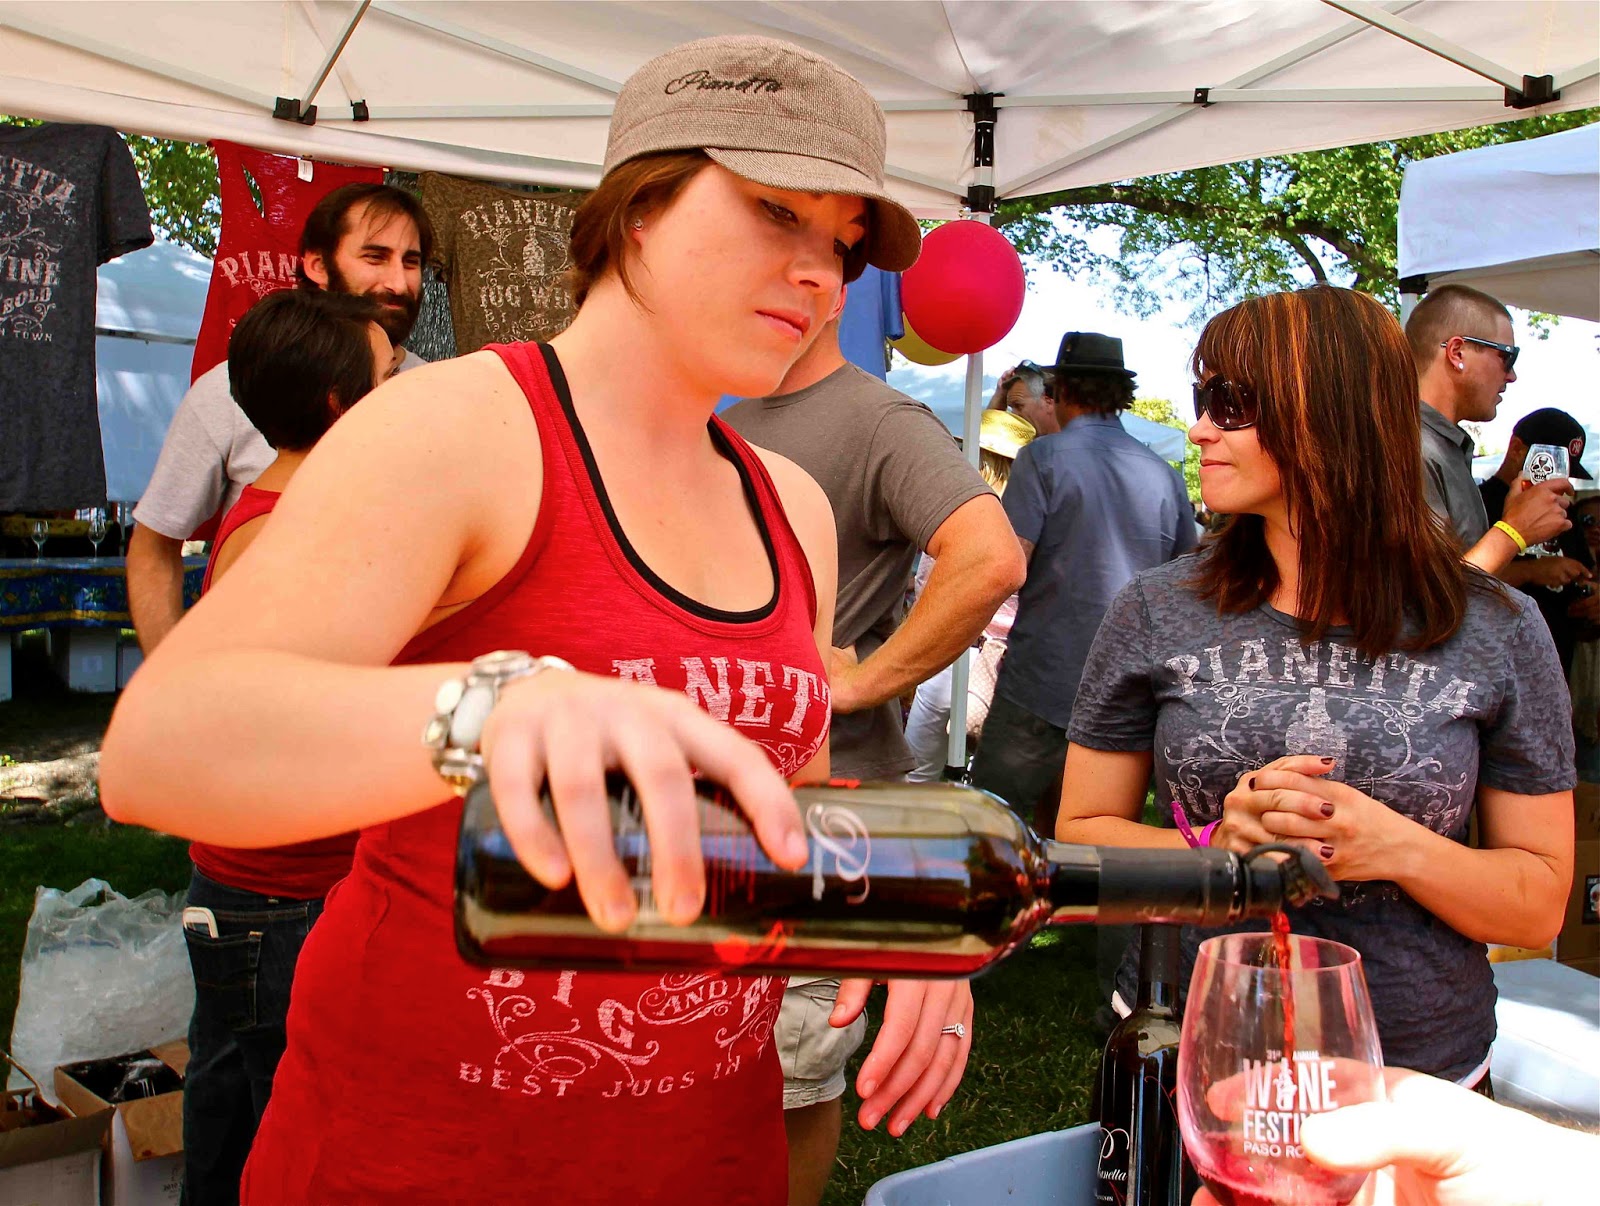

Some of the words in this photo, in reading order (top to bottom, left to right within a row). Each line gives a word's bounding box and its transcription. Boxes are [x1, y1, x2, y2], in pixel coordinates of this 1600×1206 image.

[0, 156, 76, 206] TTA
[0, 255, 61, 286] INE
[218, 250, 299, 288] PIAN
[2, 286, 52, 315] BOLD
[13, 329, 52, 342] TOWN
[1164, 637, 1480, 719] PIANETTA
[652, 979, 728, 1016] AND
[458, 1061, 574, 1096] BEST
[602, 1070, 695, 1098] JUGS
[1242, 1057, 1338, 1111] WINE
[1243, 1141, 1282, 1158] PASO
[1285, 1145, 1305, 1159] RO
